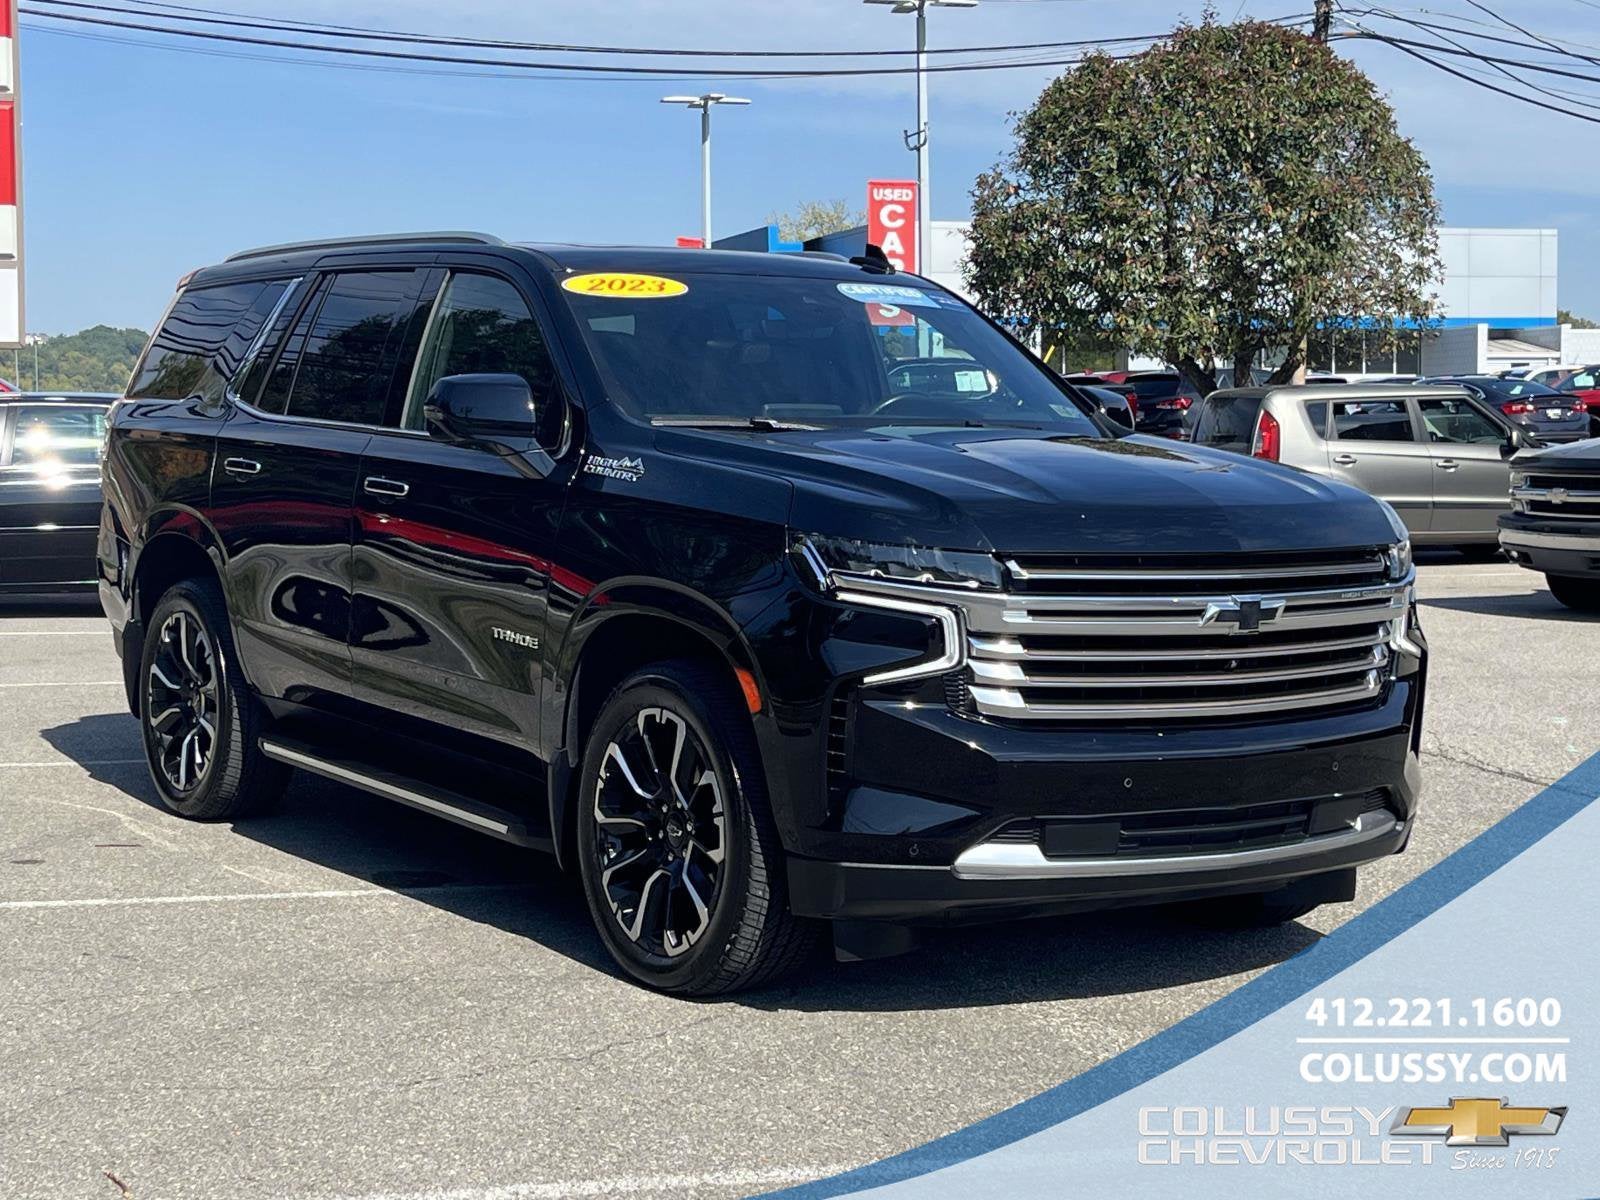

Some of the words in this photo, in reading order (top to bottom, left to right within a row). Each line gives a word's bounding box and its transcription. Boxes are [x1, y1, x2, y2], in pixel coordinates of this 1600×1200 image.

[872, 187, 914, 201] USED
[587, 278, 667, 292] 2023
[587, 455, 619, 469] HIGH
[583, 464, 643, 482] COUNTRY
[491, 626, 539, 649] TAHOE
